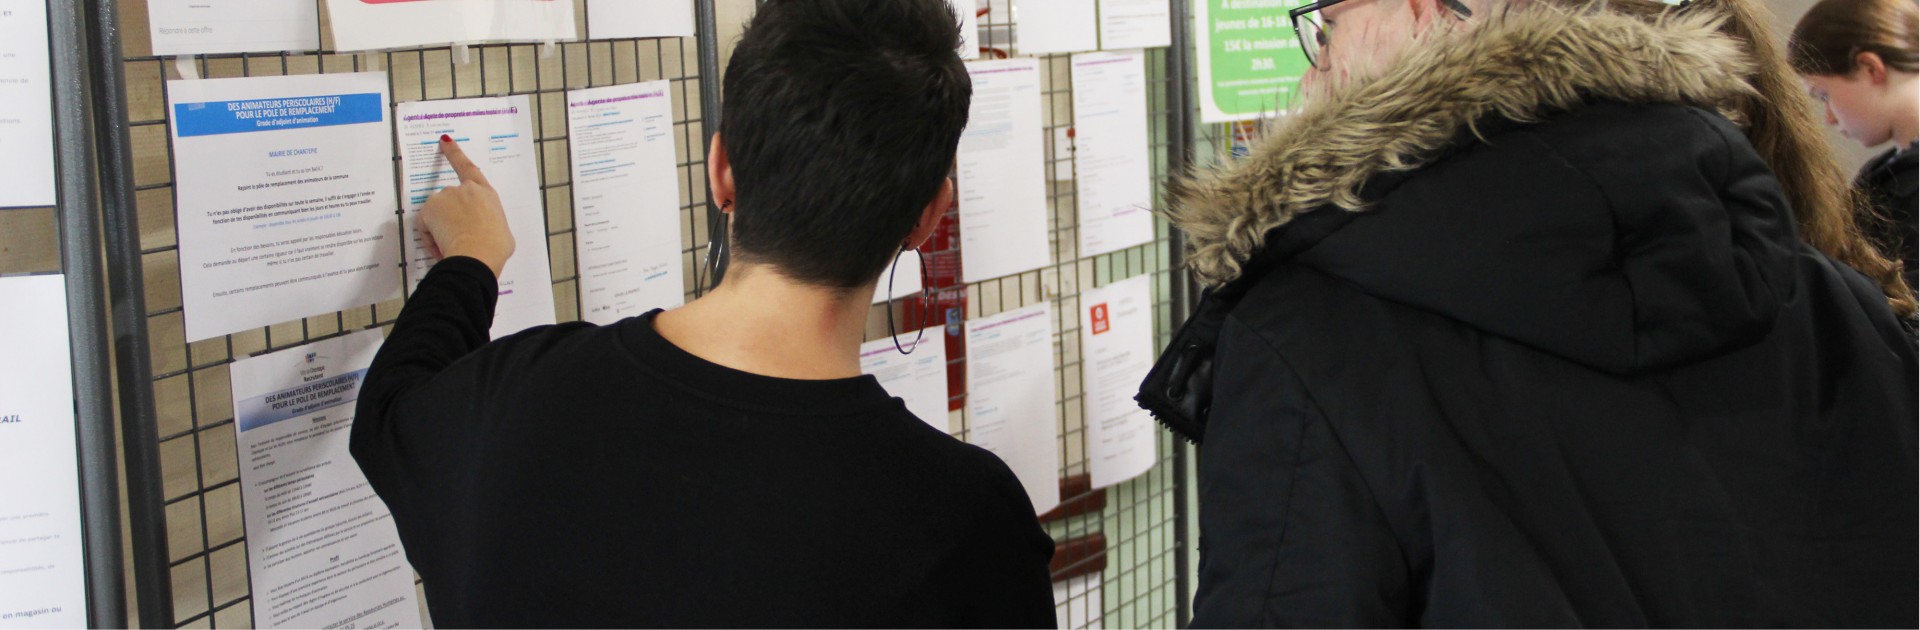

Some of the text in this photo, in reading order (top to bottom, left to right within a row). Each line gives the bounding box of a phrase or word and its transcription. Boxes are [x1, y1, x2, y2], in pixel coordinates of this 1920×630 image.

[1248, 17, 1259, 28] de
[228, 97, 340, 111] DES ANIMATEURS PERISCOLAIRES (H/F)
[236, 105, 335, 119] POUR LE POLE DE REMPLACEMENT
[272, 118, 291, 127] d'adjoint
[292, 116, 318, 124] d'animation
[269, 150, 286, 158] MAIRIE
[294, 147, 318, 155] CHANTEPIE
[271, 180, 296, 188] remplacement
[266, 395, 276, 403] DES
[277, 385, 312, 400] ANIMATEURS
[272, 400, 288, 410] POUR
[318, 382, 355, 398] REMPLACEMENT
[16, 608, 49, 619] magasin
